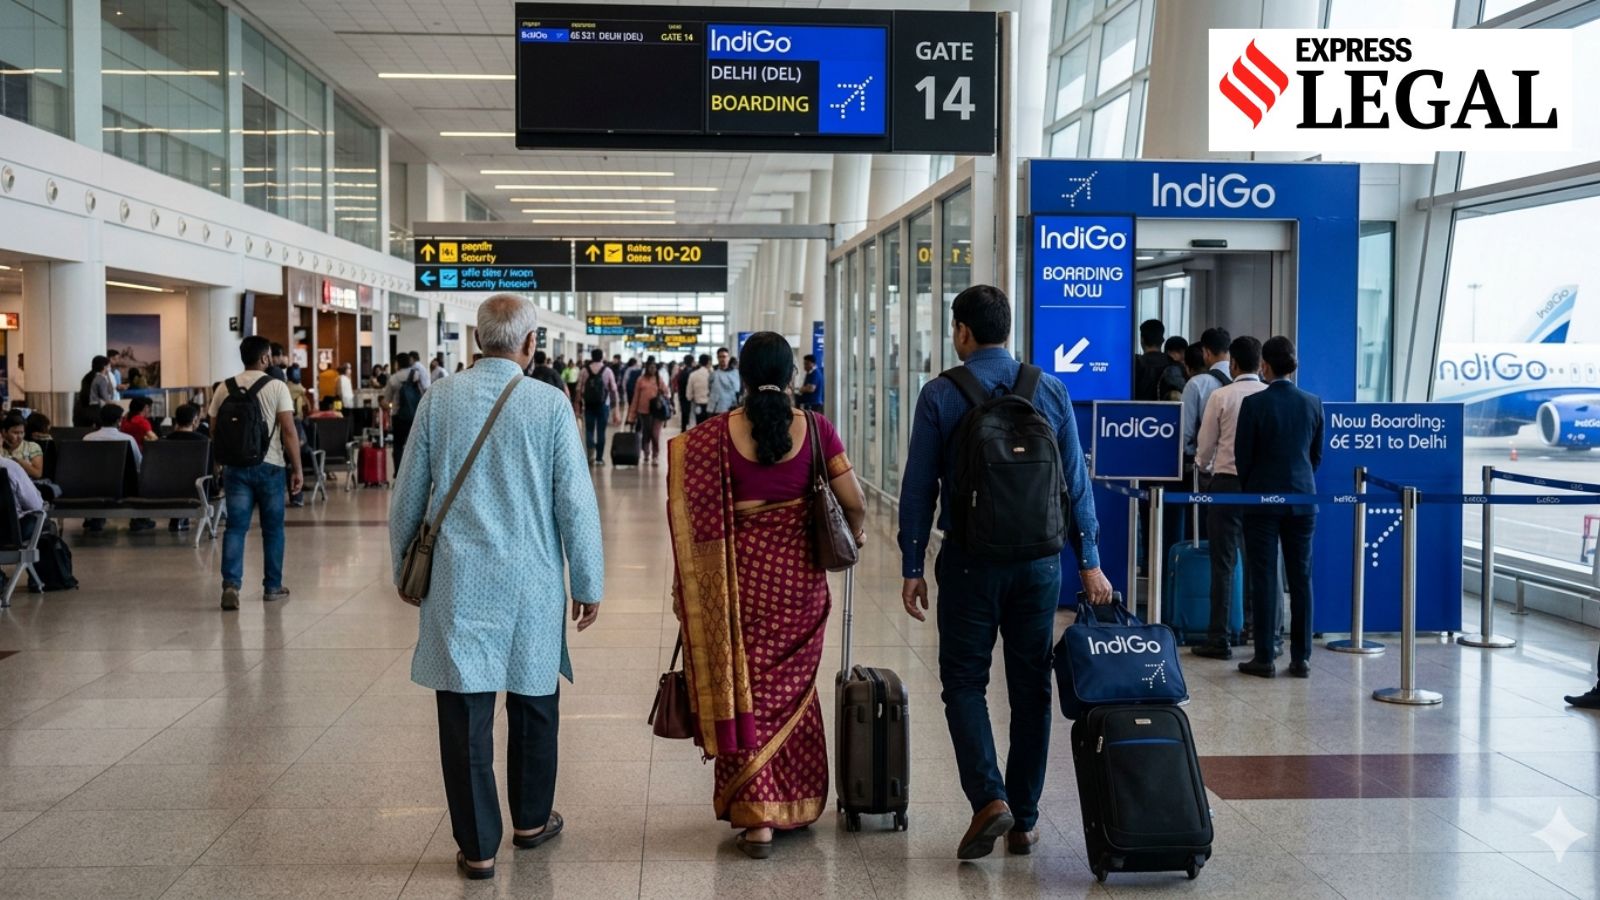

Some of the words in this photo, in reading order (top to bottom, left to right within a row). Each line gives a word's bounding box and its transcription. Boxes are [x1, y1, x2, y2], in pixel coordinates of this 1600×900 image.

[661, 33, 682, 41] GATE
[684, 33, 694, 41] 14
[710, 29, 791, 54] IndiGo
[915, 41, 974, 62] GATE
[711, 66, 757, 81] DELHI
[761, 66, 802, 84] (DEL)
[711, 95, 810, 113] BOARDING
[914, 75, 976, 121] 14
[1152, 172, 1276, 209] IndiGo
[1040, 224, 1127, 250] IndiGo
[655, 246, 702, 262] 10-20
[1063, 283, 1102, 298] NOW
[1438, 352, 1547, 381] ndiGo
[1100, 416, 1176, 439] IndiGo
[1331, 413, 1366, 429] Now
[1371, 413, 1446, 432] Boarding:
[1354, 434, 1382, 449] 521
[1387, 435, 1404, 449] to
[1408, 434, 1448, 449] Delhi
